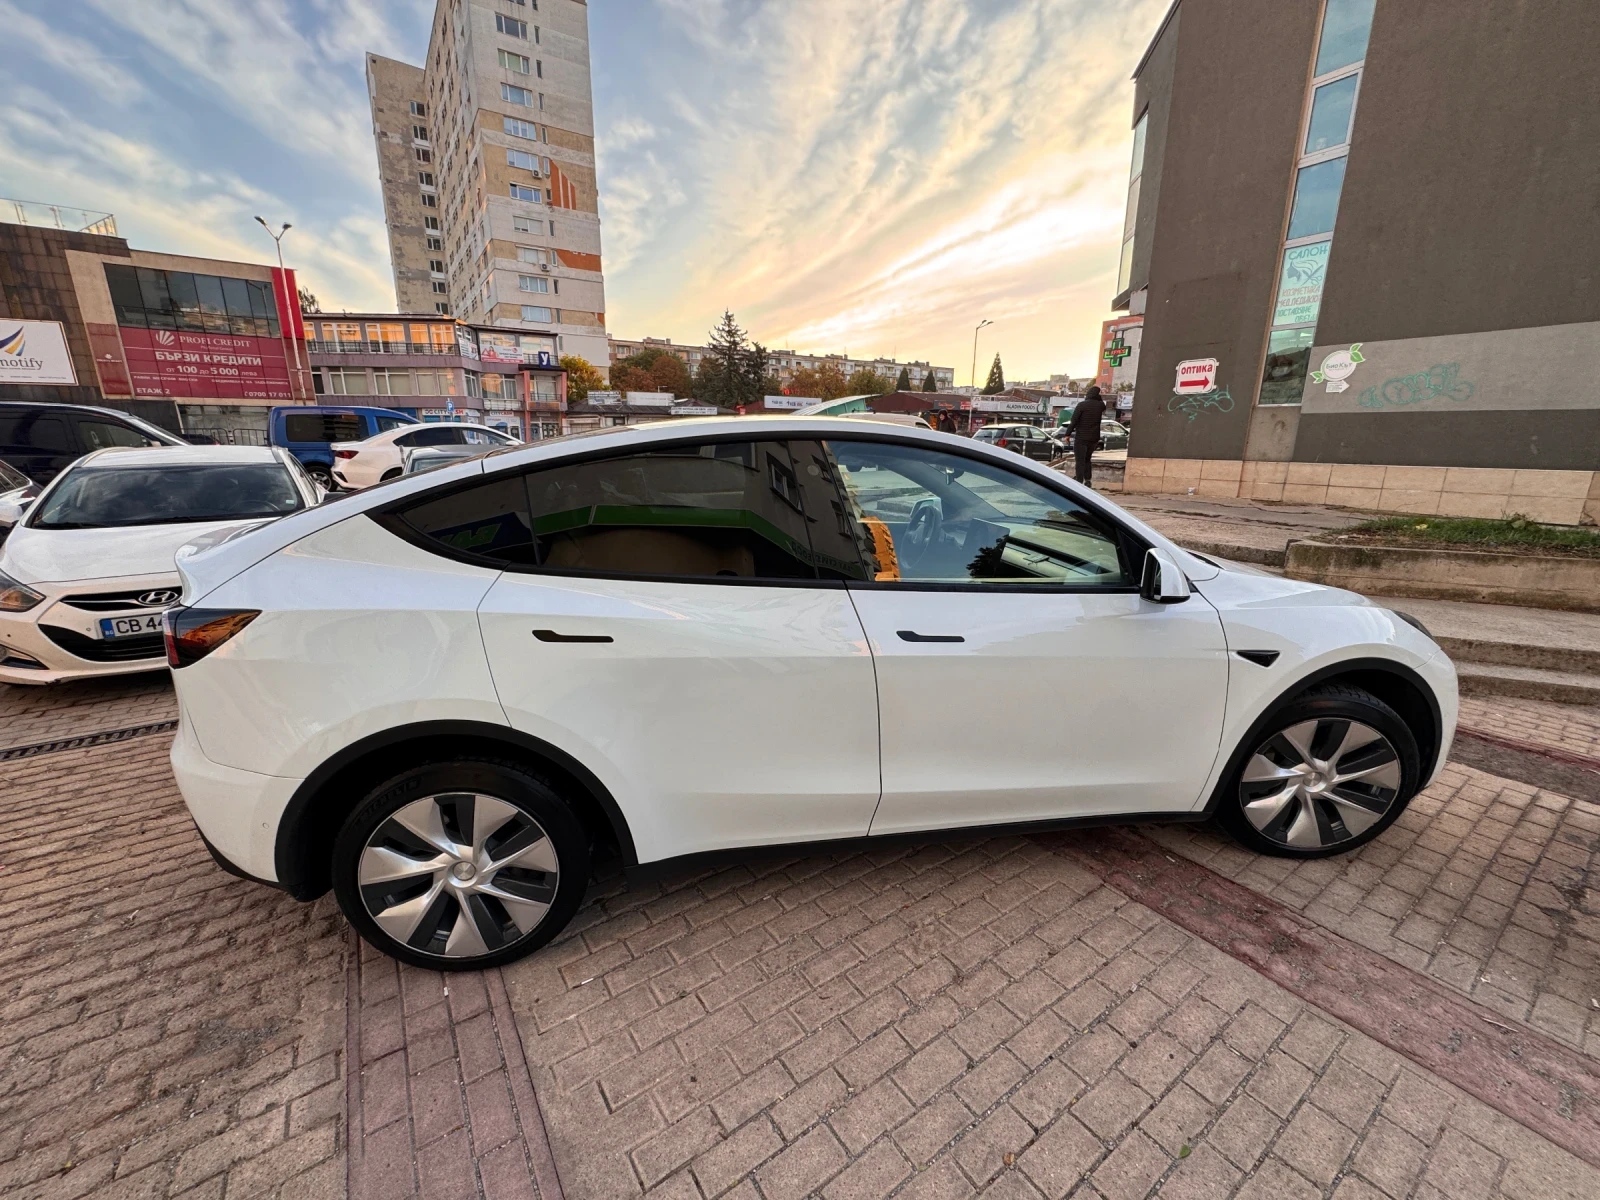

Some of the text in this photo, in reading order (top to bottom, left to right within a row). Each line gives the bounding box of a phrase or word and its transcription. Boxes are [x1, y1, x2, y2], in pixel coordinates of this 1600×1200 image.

[1288, 245, 1328, 260] САЛОН
[1282, 286, 1320, 297] КОЗМЕТИКА
[179, 335, 211, 345] PROFI
[213, 337, 252, 348] CREDIT
[155, 351, 262, 366] БЪРЗИ КРЕДИТИ
[176, 366, 198, 374] 100
[116, 619, 142, 634] CB
